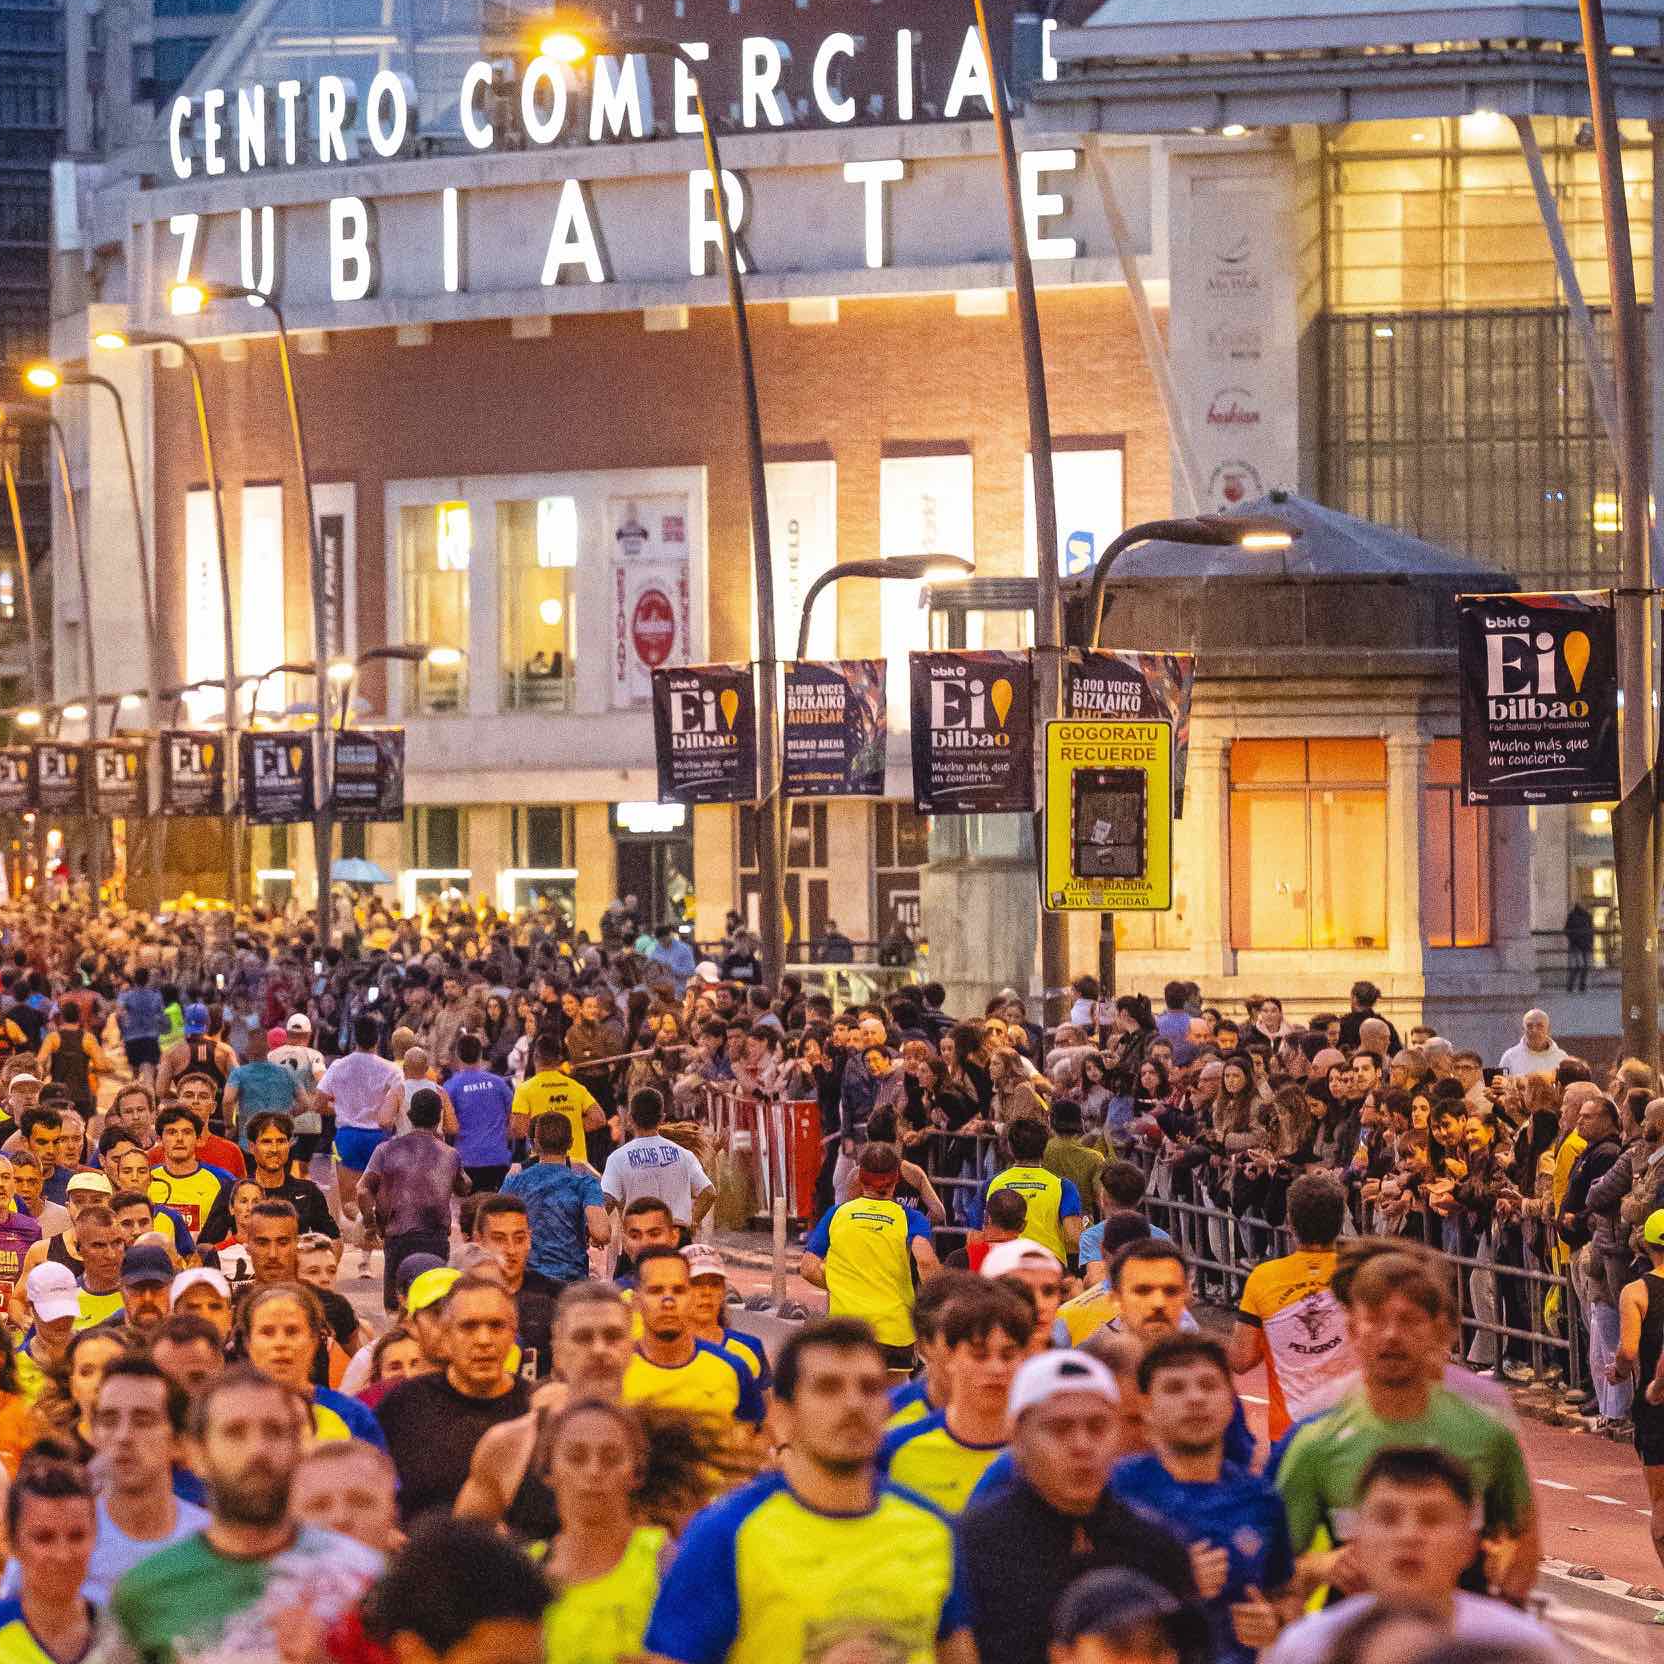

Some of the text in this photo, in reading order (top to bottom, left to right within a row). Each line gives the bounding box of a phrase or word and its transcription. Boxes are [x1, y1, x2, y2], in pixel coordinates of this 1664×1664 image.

[169, 69, 408, 180] CENTRO
[169, 148, 1077, 308] ZUBIARTE
[1485, 616, 1517, 628] bbk
[1107, 680, 1142, 695] VOCES
[787, 695, 845, 709] BIZKAIKO
[1072, 692, 1142, 712] BIZKAIKO
[1488, 697, 1590, 721] bilbao
[787, 710, 845, 724] AHOTSAK
[1059, 727, 1158, 740] GOGORATU
[1506, 722, 1542, 732] Saturday
[1543, 721, 1591, 730] Foundation
[672, 734, 737, 749] bilbao
[930, 729, 1010, 749] bilbao
[1488, 738, 1590, 752] Mucho más que
[1060, 747, 1157, 761] RECUERDE
[1488, 752, 1566, 766] un concierto
[1068, 897, 1083, 906] SU
[627, 1145, 680, 1167] RACING TEAM
[1287, 1336, 1343, 1354] PELIGROS
